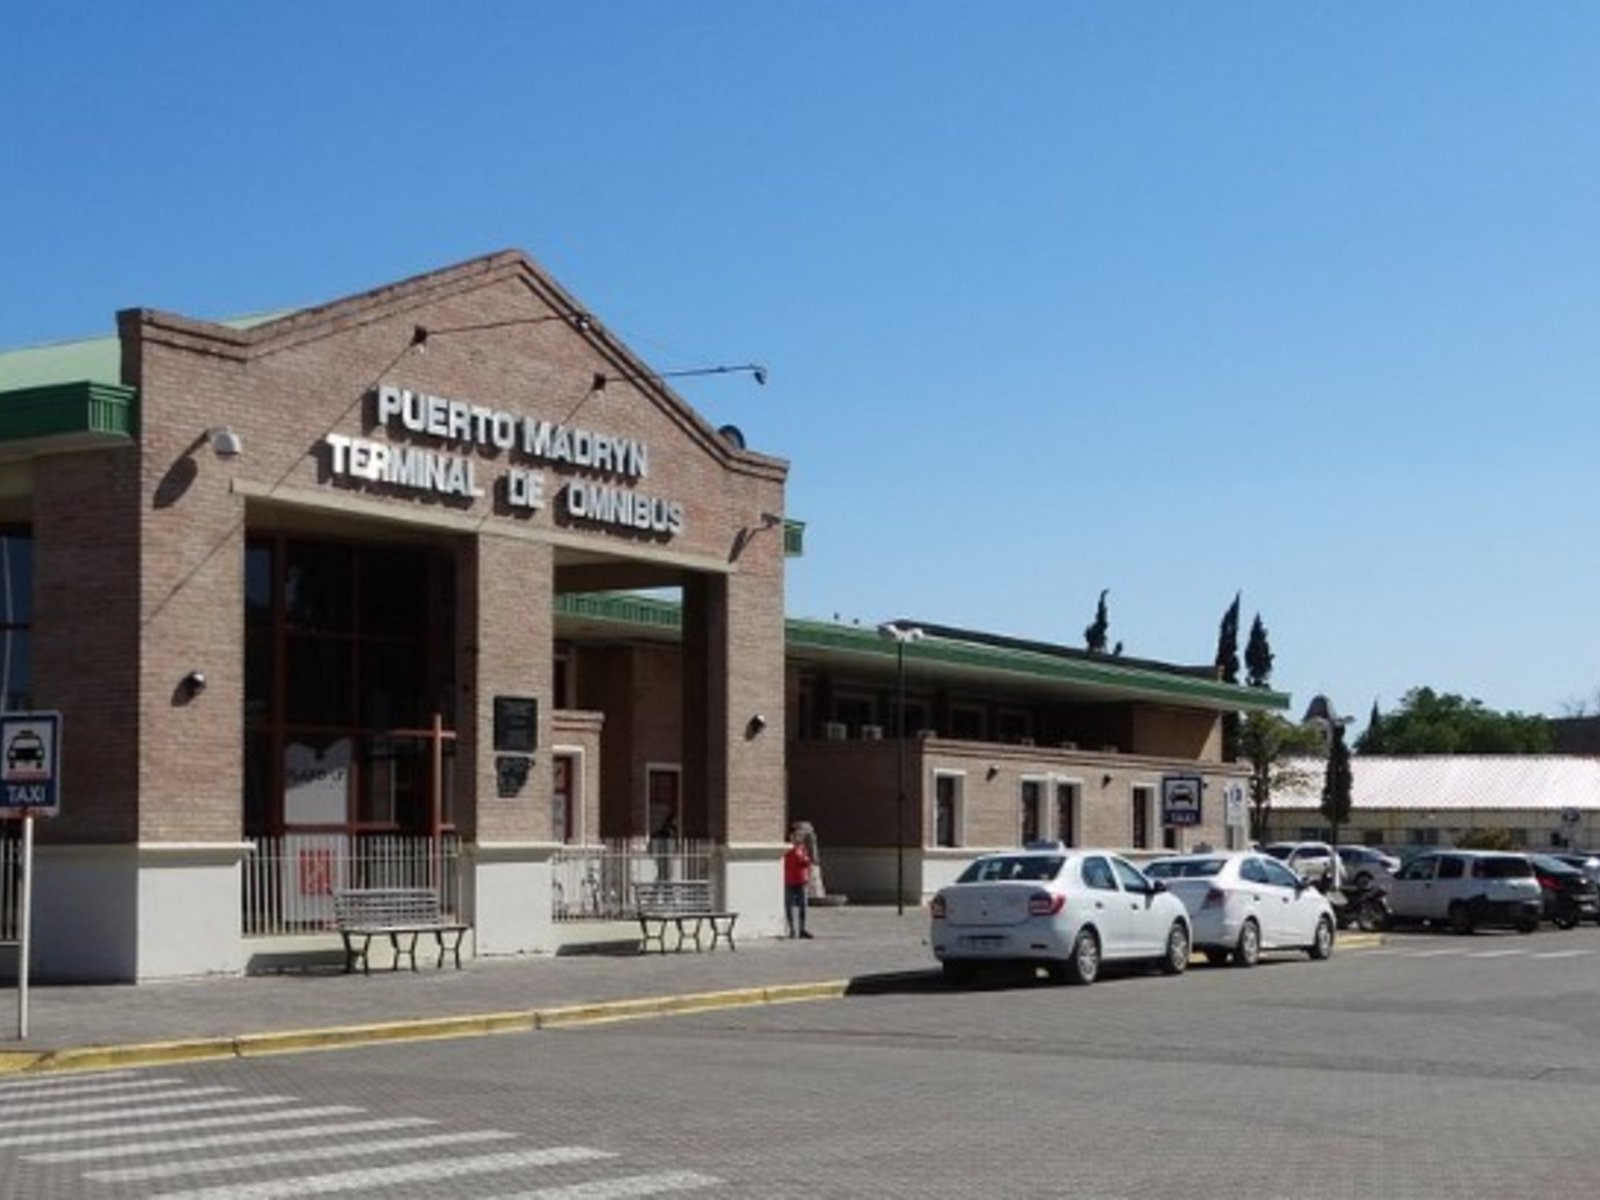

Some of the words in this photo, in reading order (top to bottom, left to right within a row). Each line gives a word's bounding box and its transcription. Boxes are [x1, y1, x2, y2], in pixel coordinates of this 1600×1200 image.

[378, 384, 517, 450] PUERTO
[523, 416, 647, 477] MADRYN
[326, 433, 485, 497] TERMINAL
[508, 468, 546, 509] DE
[567, 477, 684, 534] OMNIBUS
[7, 785, 46, 803] TAXI
